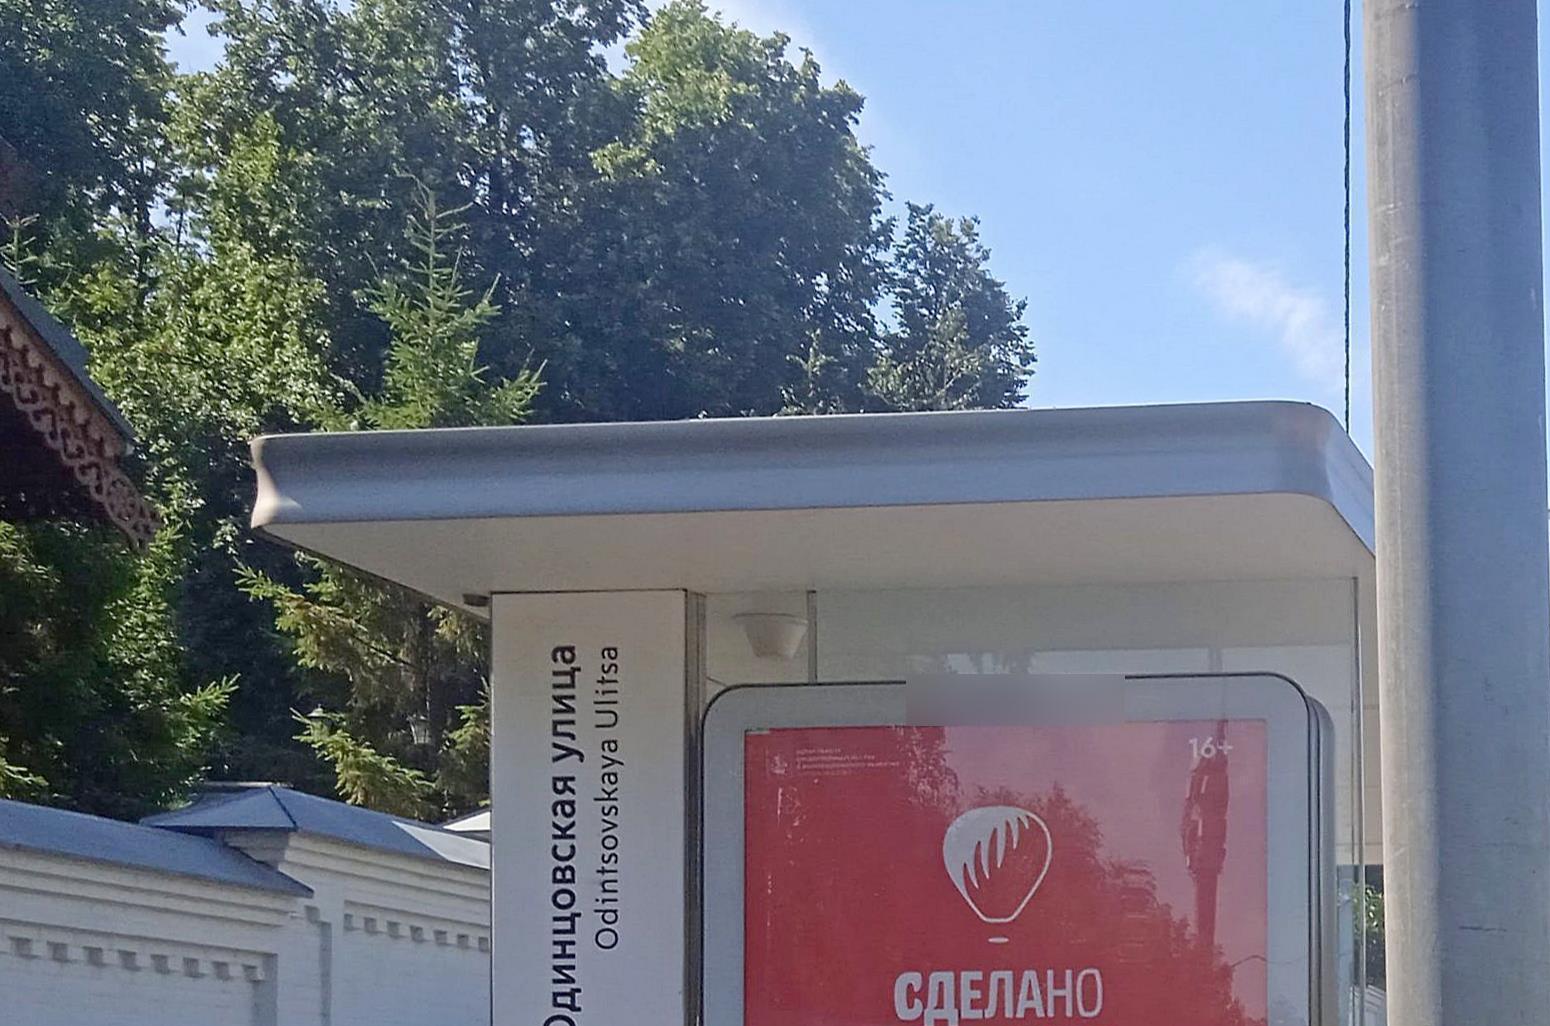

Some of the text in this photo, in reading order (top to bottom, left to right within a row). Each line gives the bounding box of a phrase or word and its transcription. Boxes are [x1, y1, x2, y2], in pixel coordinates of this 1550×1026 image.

[550, 644, 584, 763] улица
[1188, 737, 1233, 759] 16+
[594, 646, 624, 949] Odintsovskaya Ulitsa
